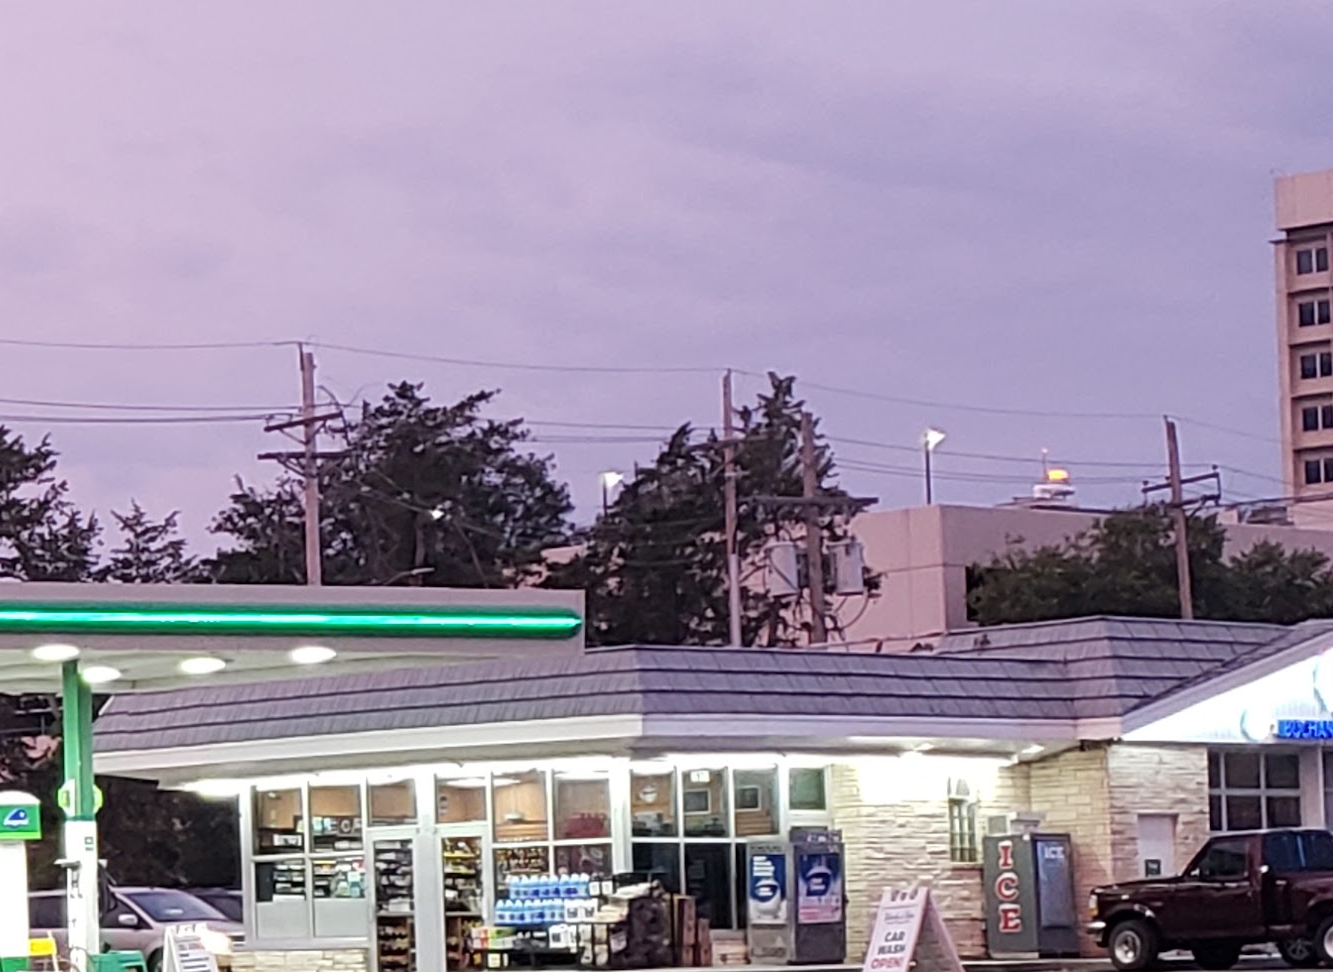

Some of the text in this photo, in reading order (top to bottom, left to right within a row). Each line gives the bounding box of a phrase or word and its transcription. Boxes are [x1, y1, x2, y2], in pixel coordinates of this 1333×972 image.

[1044, 846, 1065, 859] ICE
[995, 840, 1022, 933] ICE
[884, 930, 906, 943] CAR
[877, 943, 906, 956] WASH
